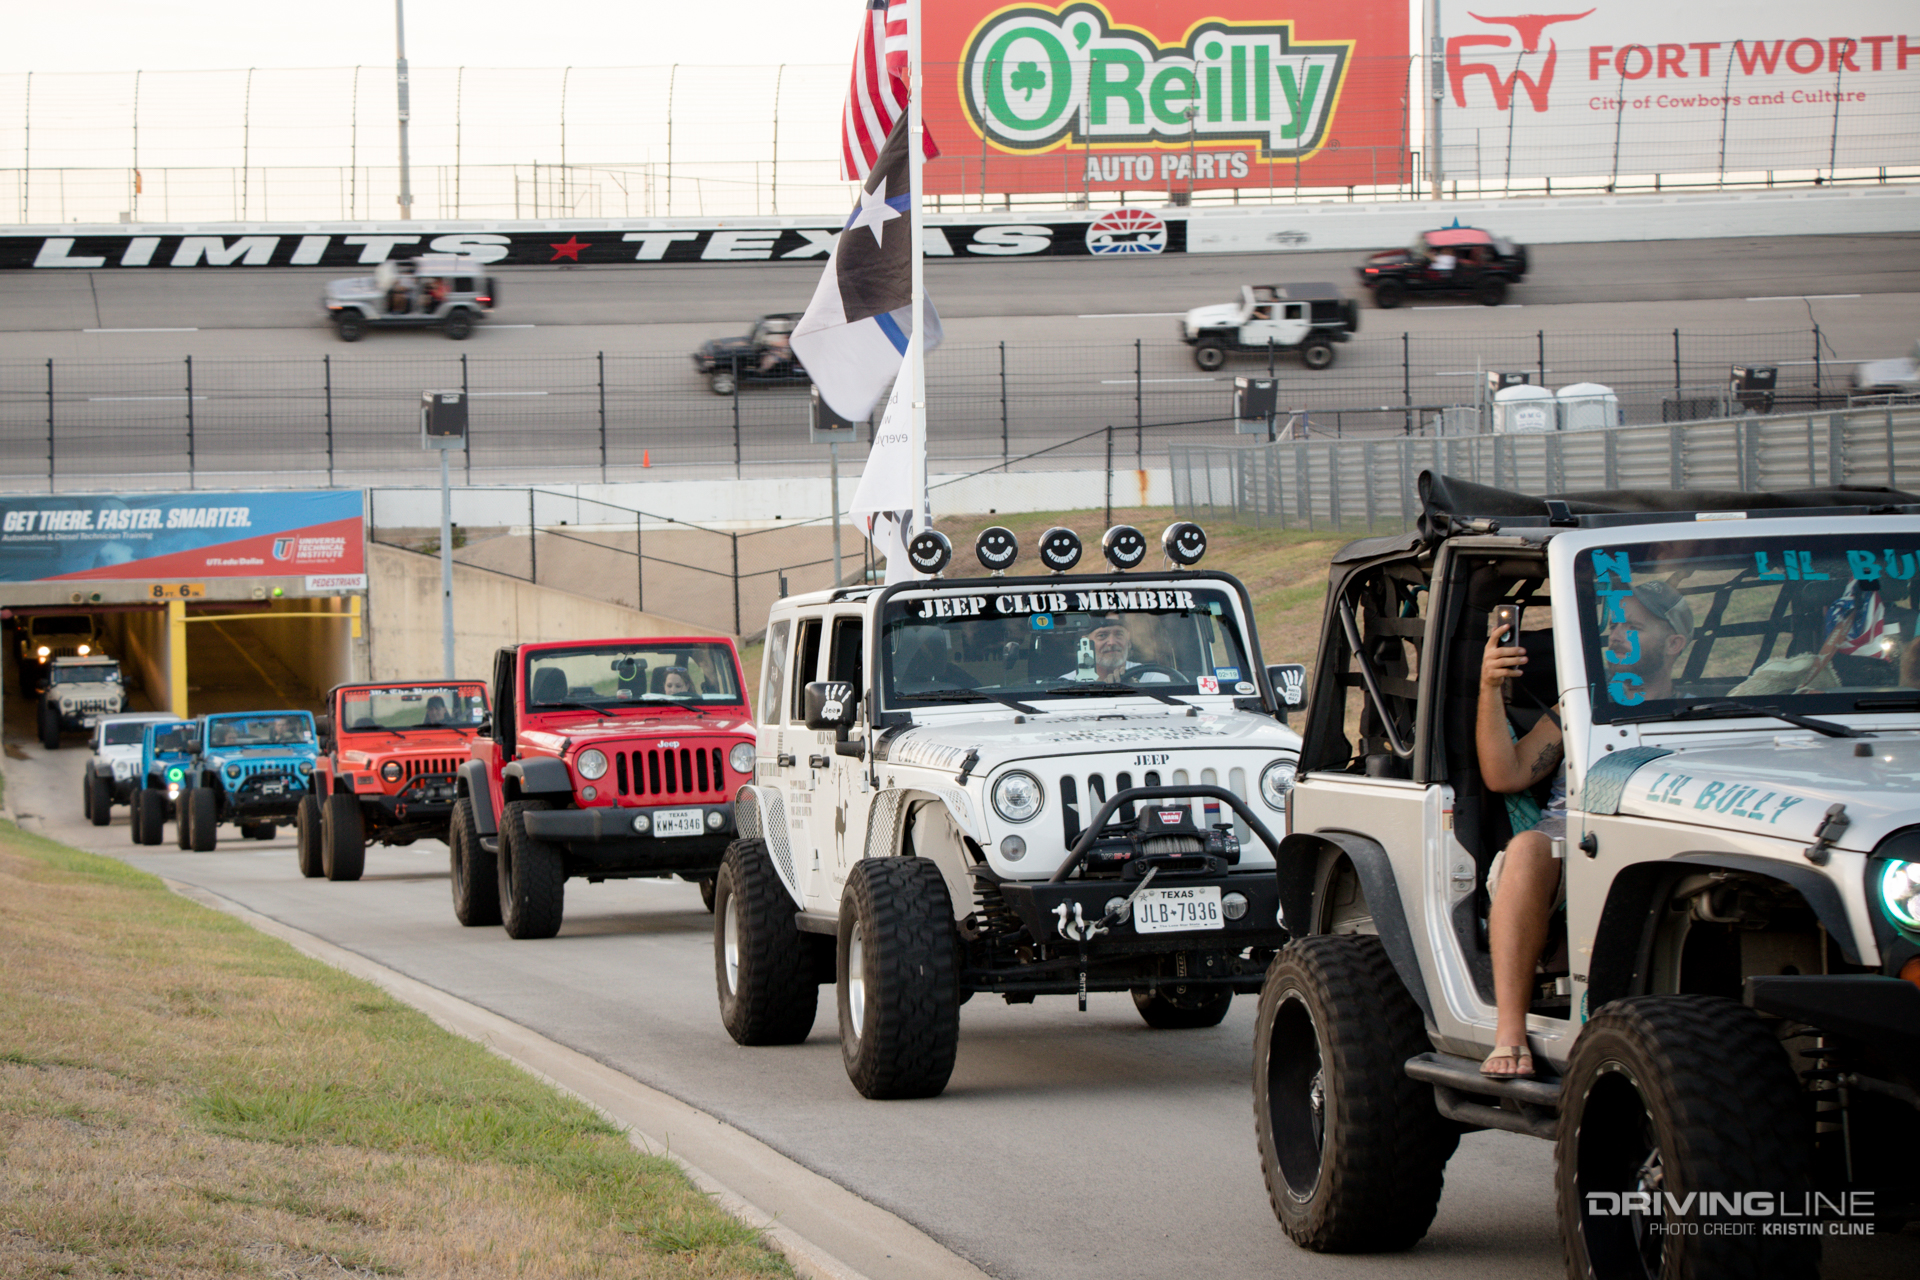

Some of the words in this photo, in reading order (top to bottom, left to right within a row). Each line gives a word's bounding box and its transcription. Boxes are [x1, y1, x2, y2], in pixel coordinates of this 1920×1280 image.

[1589, 42, 1721, 81] FORT
[983, 21, 1325, 140] O'Reilly
[1589, 97, 1627, 116] City
[1632, 95, 1651, 110] of
[1656, 92, 1742, 113] Cowboys
[1748, 92, 1785, 106] and
[1791, 89, 1867, 105] Culture
[1083, 156, 1154, 182] AUTO
[1161, 152, 1249, 181] PARTS
[33, 234, 511, 268] LIMITS
[3, 511, 39, 532] GET
[39, 510, 95, 531] THERE.
[97, 508, 164, 530] FASTER.
[166, 507, 252, 529] SMARTER.
[1, 534, 48, 542] Automotive
[55, 533, 79, 541] Diesel
[80, 532, 121, 540] Technician
[122, 531, 153, 540] Training
[299, 537, 346, 545] UNIVERSAL
[1755, 550, 1831, 581] LIL
[1846, 549, 1920, 582] BU
[153, 585, 163, 598] 8
[179, 584, 190, 597] 6
[311, 577, 361, 587] PEDESTRIANS
[918, 596, 987, 619] JEEP
[995, 592, 1068, 615] CLUB
[1075, 590, 1196, 612] MEMBER
[824, 707, 840, 715] Jeep
[657, 740, 680, 749] Jeep
[1133, 754, 1170, 766] JEEP
[1647, 773, 1693, 806] LIL
[1694, 781, 1804, 824] BULLY
[1161, 890, 1194, 899] TEXAS
[1079, 971, 1087, 1001] CRITTER
